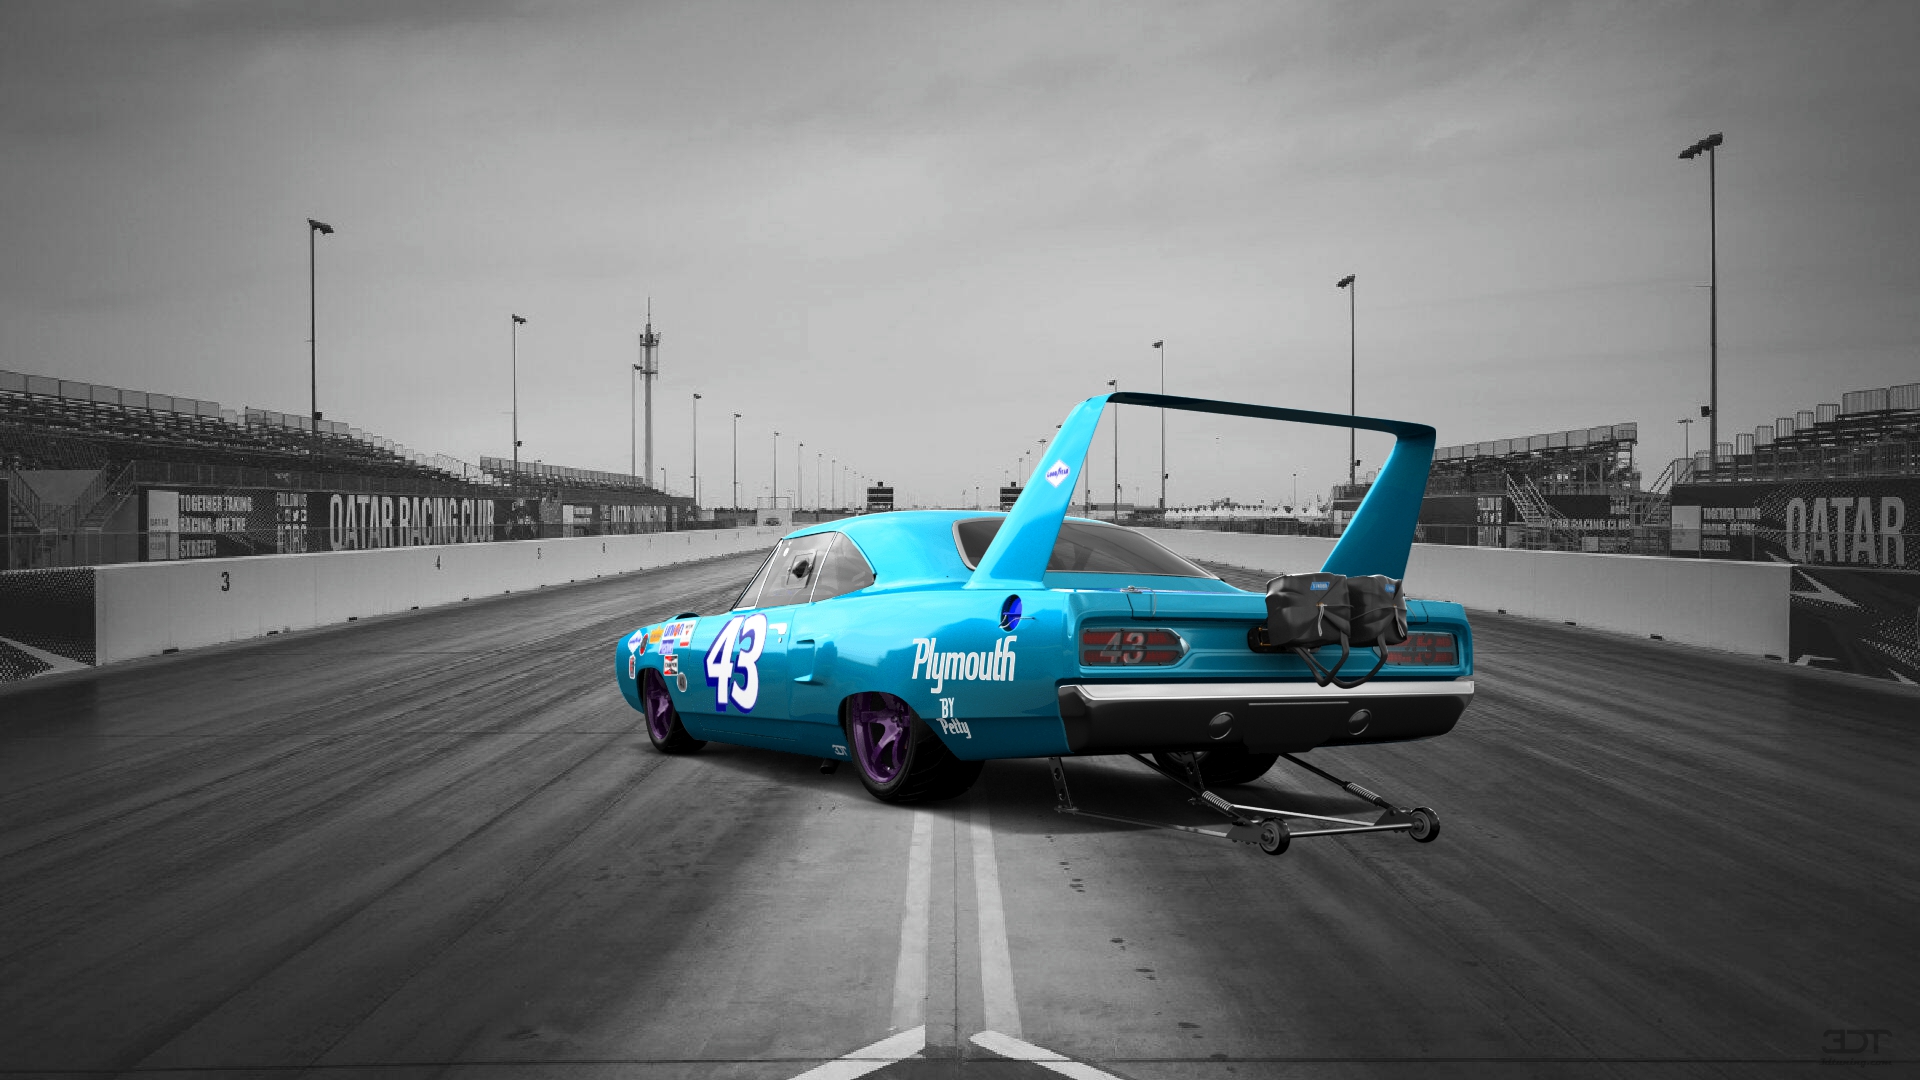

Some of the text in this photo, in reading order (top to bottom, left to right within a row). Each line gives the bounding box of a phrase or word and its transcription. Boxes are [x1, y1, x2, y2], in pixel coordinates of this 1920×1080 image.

[330, 493, 393, 551] QATAR
[399, 496, 458, 547] RACING
[461, 497, 495, 543] CLUB
[1786, 496, 1905, 566] QATAR
[434, 555, 442, 570] 4
[221, 571, 230, 592] 3
[704, 613, 767, 714] 43
[1100, 632, 1148, 664] 43
[1402, 633, 1437, 665] 43
[911, 636, 1017, 694] Plymouth
[939, 697, 955, 719] BY
[936, 718, 972, 739] Petty
